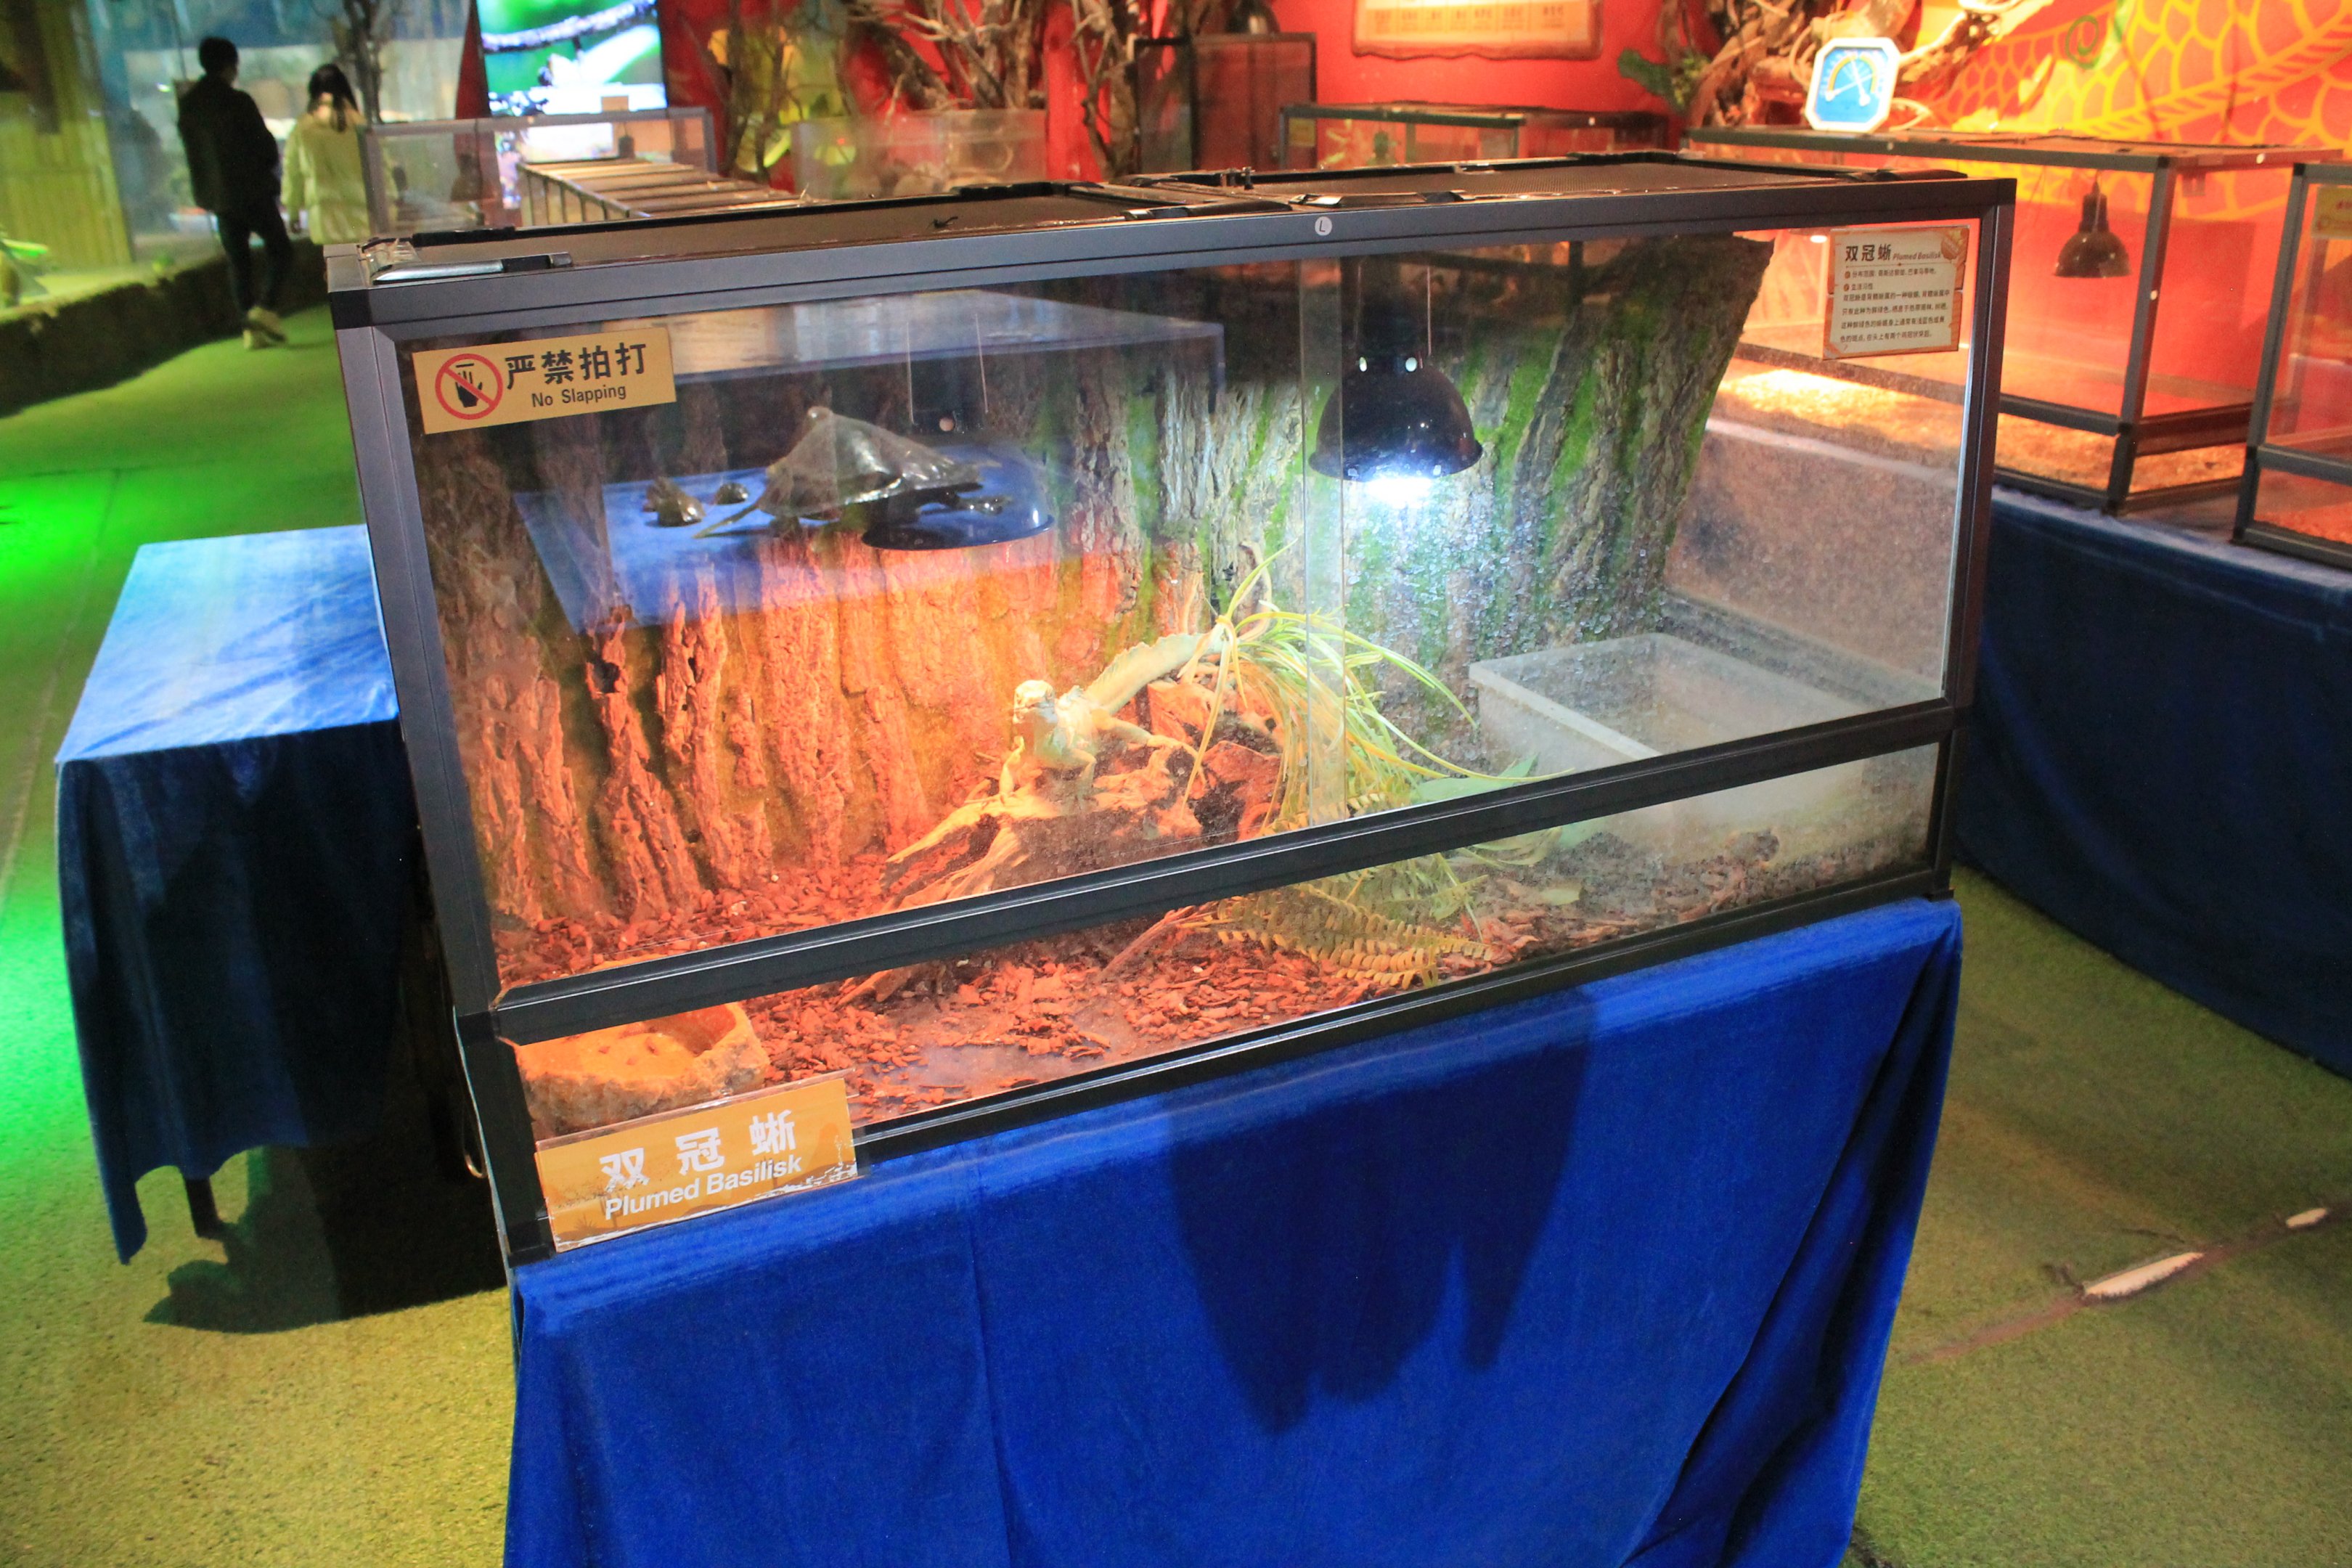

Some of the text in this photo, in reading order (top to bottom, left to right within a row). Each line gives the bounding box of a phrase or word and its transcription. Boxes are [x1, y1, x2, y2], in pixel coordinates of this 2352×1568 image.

[1845, 243, 1891, 262] 双冠蜥
[1918, 250, 1941, 260] Basilisk
[505, 342, 647, 390] 严禁拍打
[531, 385, 626, 408] No Slapping
[599, 1109, 796, 1193] 双冠蜥
[605, 1154, 802, 1220] Plumed Basilisk
